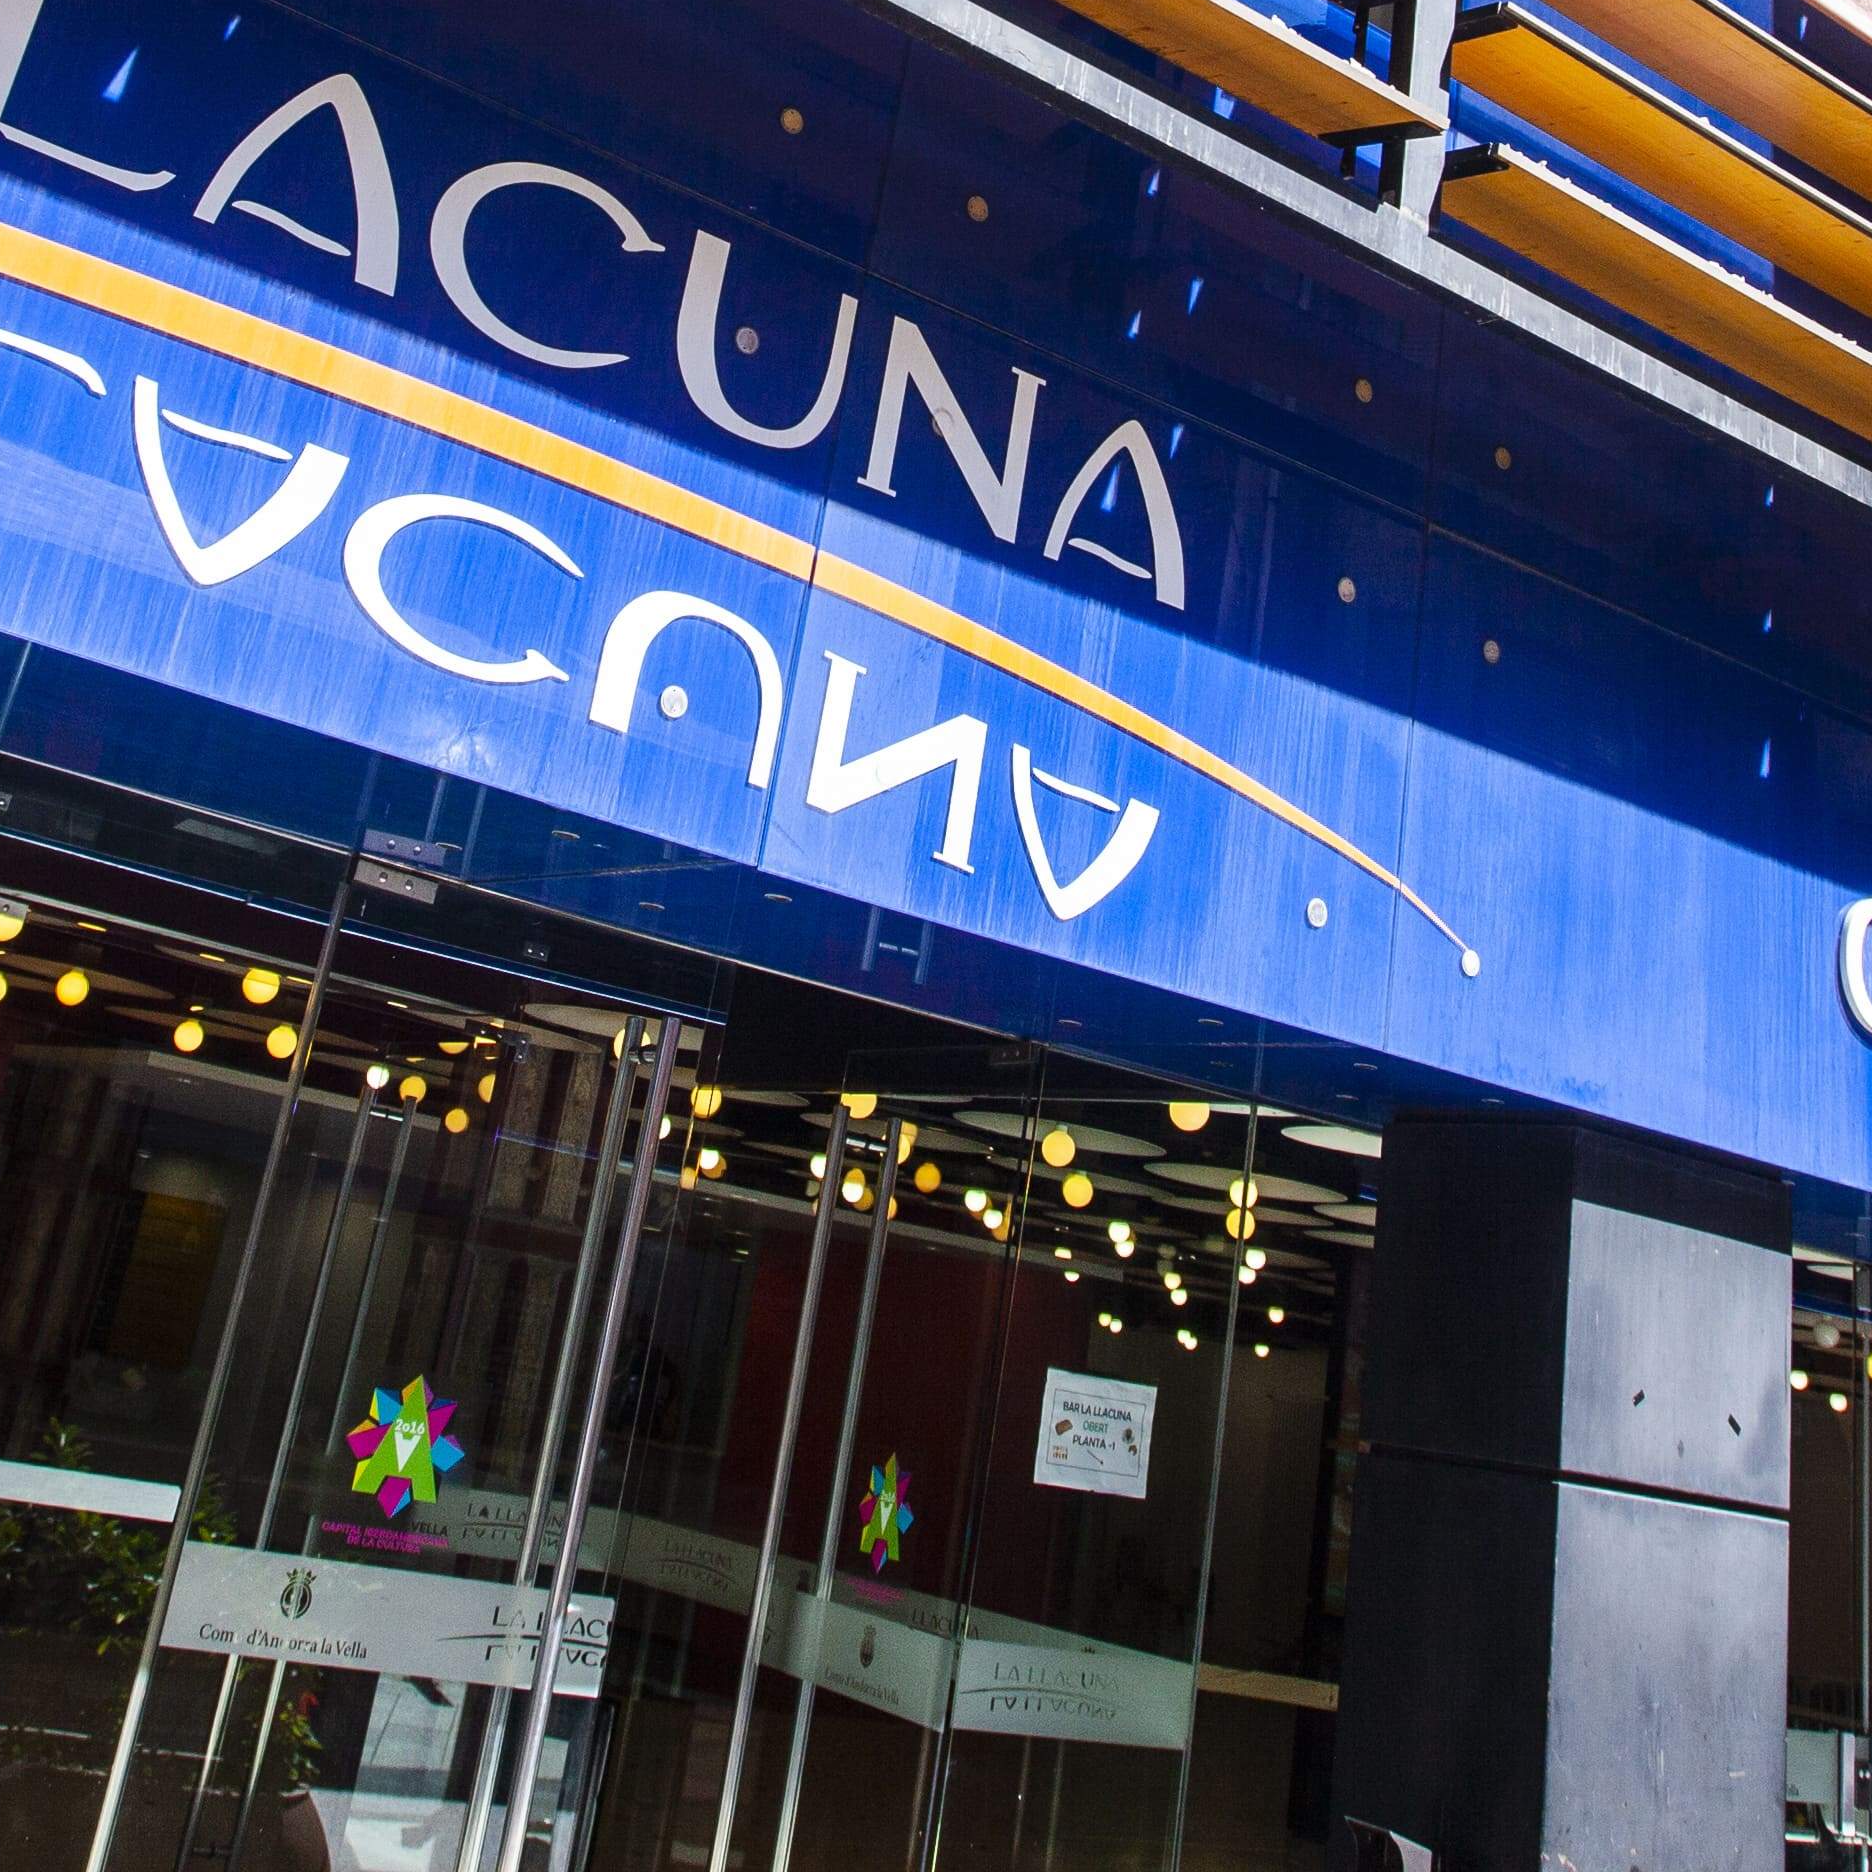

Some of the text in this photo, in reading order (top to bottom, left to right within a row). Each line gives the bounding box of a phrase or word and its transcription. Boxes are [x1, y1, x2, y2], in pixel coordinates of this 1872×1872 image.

[1063, 1401, 1132, 1422] BAR LA LLACUNA
[394, 1418, 426, 1435] 2016
[1082, 1420, 1108, 1434] OBERT
[1072, 1434, 1106, 1450] PLANTA
[199, 1623, 368, 1660] Com d'Anorra la Vella
